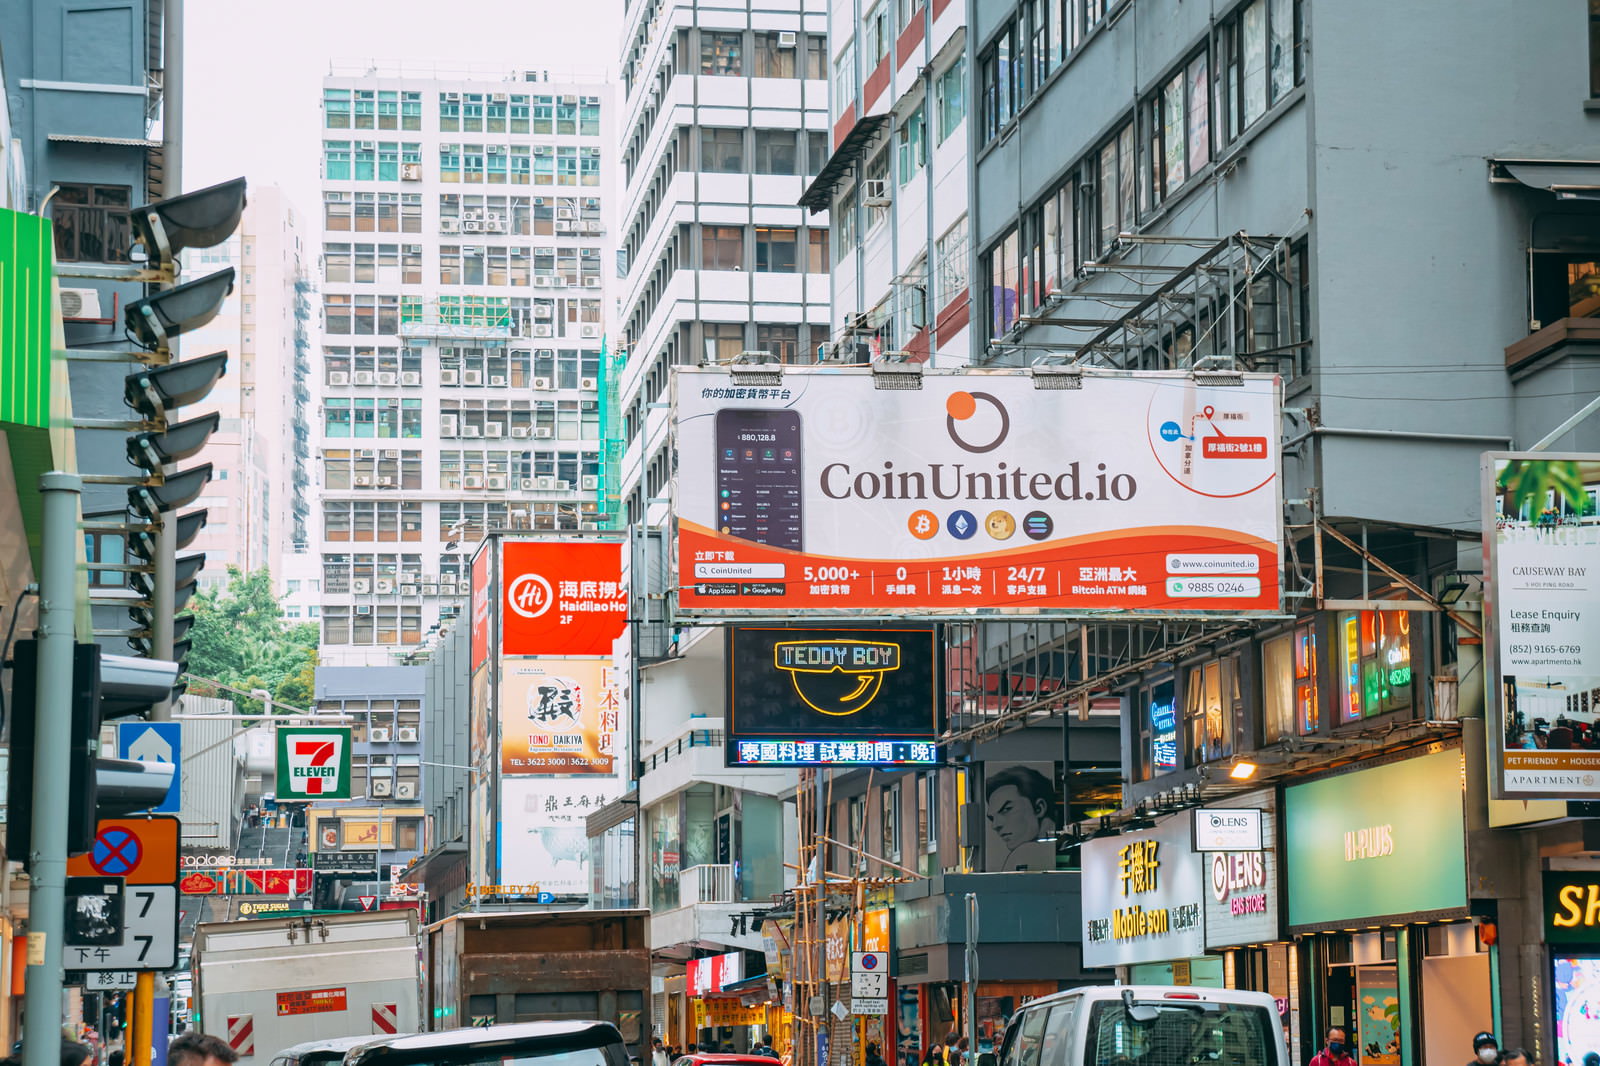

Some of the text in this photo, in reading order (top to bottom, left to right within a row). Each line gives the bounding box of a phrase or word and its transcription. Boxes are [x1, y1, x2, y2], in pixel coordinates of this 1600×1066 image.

[701, 387, 791, 400] 你的加密貨幣平台
[820, 461, 1137, 501] CoinUnited.io
[694, 551, 735, 561] 立即下載
[1182, 560, 1255, 569] www.coinunited.io
[711, 567, 752, 575] CoinUnited
[803, 567, 860, 582] 5,000+
[896, 567, 907, 581] 0
[942, 566, 981, 581] 1小時
[1007, 566, 1046, 581] 24/7
[1079, 566, 1137, 582] 亞洲最大
[1512, 567, 1587, 577] CAUSEWAY BAY
[810, 585, 850, 596] 加密貨幣
[886, 585, 916, 596] 手續費
[1007, 585, 1047, 596] 客戶支援
[1072, 585, 1105, 596] Bitcoin
[1106, 585, 1127, 596] ATM
[1188, 582, 1245, 594] 9885 0246
[518, 582, 544, 608] Hi
[559, 601, 627, 613] Haidilao Ho
[559, 615, 573, 624] 2F
[1510, 609, 1580, 622] Lease Enquiry
[1511, 623, 1551, 633] 租務查詢
[782, 647, 892, 665] TEDDY BOY
[1509, 645, 1581, 655] (852) 9165-6769
[1511, 658, 1582, 666] www.apartmento.hk
[529, 735, 583, 745] TONO DAIKIYA
[742, 743, 815, 761] 泰國料理
[510, 757, 609, 766] TEL: 3622 3000 3622 3009
[1508, 757, 1521, 765] PET
[1523, 757, 1559, 766] FRIENDLY
[294, 767, 335, 777] ELEVEN
[295, 741, 335, 795] 7
[1210, 813, 1248, 828] OLENS
[1118, 840, 1161, 896] 手機仔
[540, 893, 549, 903] P
[1231, 893, 1265, 914] LENS STORE
[135, 892, 155, 918] 7
[1112, 905, 1147, 939] Mobile
[1147, 908, 1169, 934] son
[74, 935, 153, 963] 下午 7
[98, 971, 135, 985] 終止
[874, 974, 881, 983] 7
[874, 987, 881, 996] 7
